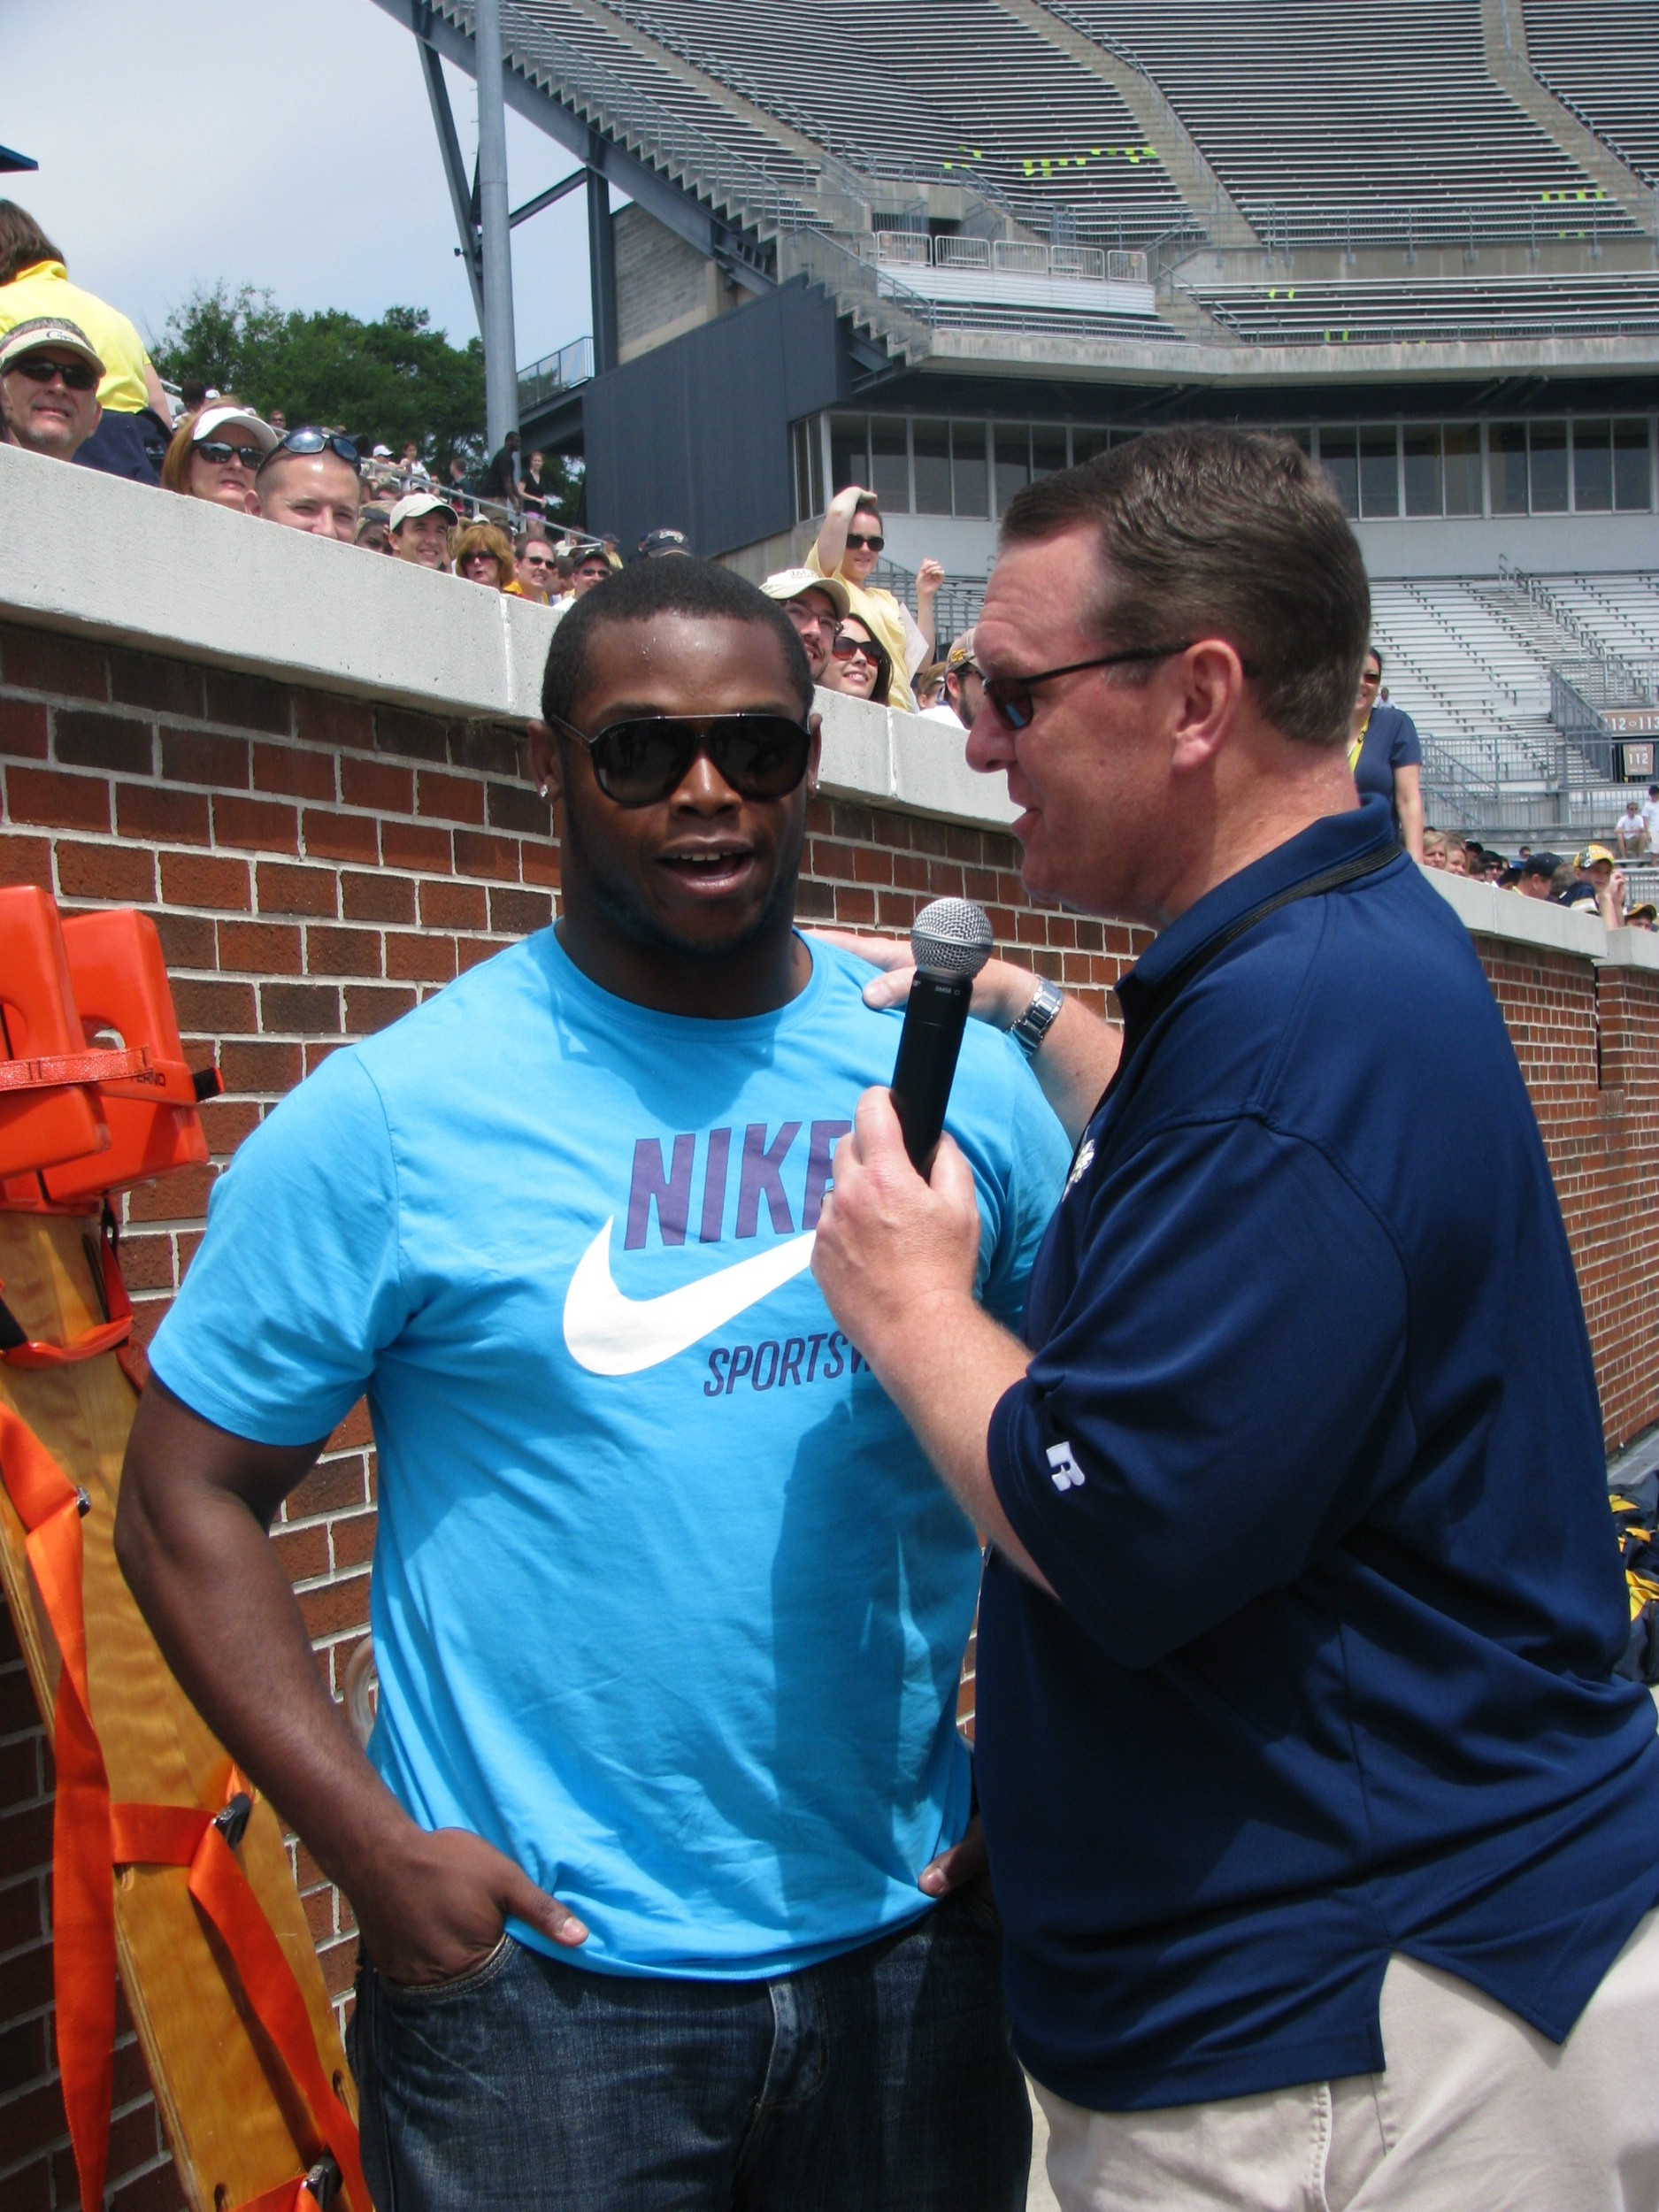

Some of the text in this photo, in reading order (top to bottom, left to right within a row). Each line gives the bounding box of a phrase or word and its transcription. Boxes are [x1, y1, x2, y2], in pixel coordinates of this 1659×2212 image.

[1629, 753, 1648, 765] 112
[130, 1070, 166, 1087] ERNO
[624, 1119, 852, 1251] NIKE
